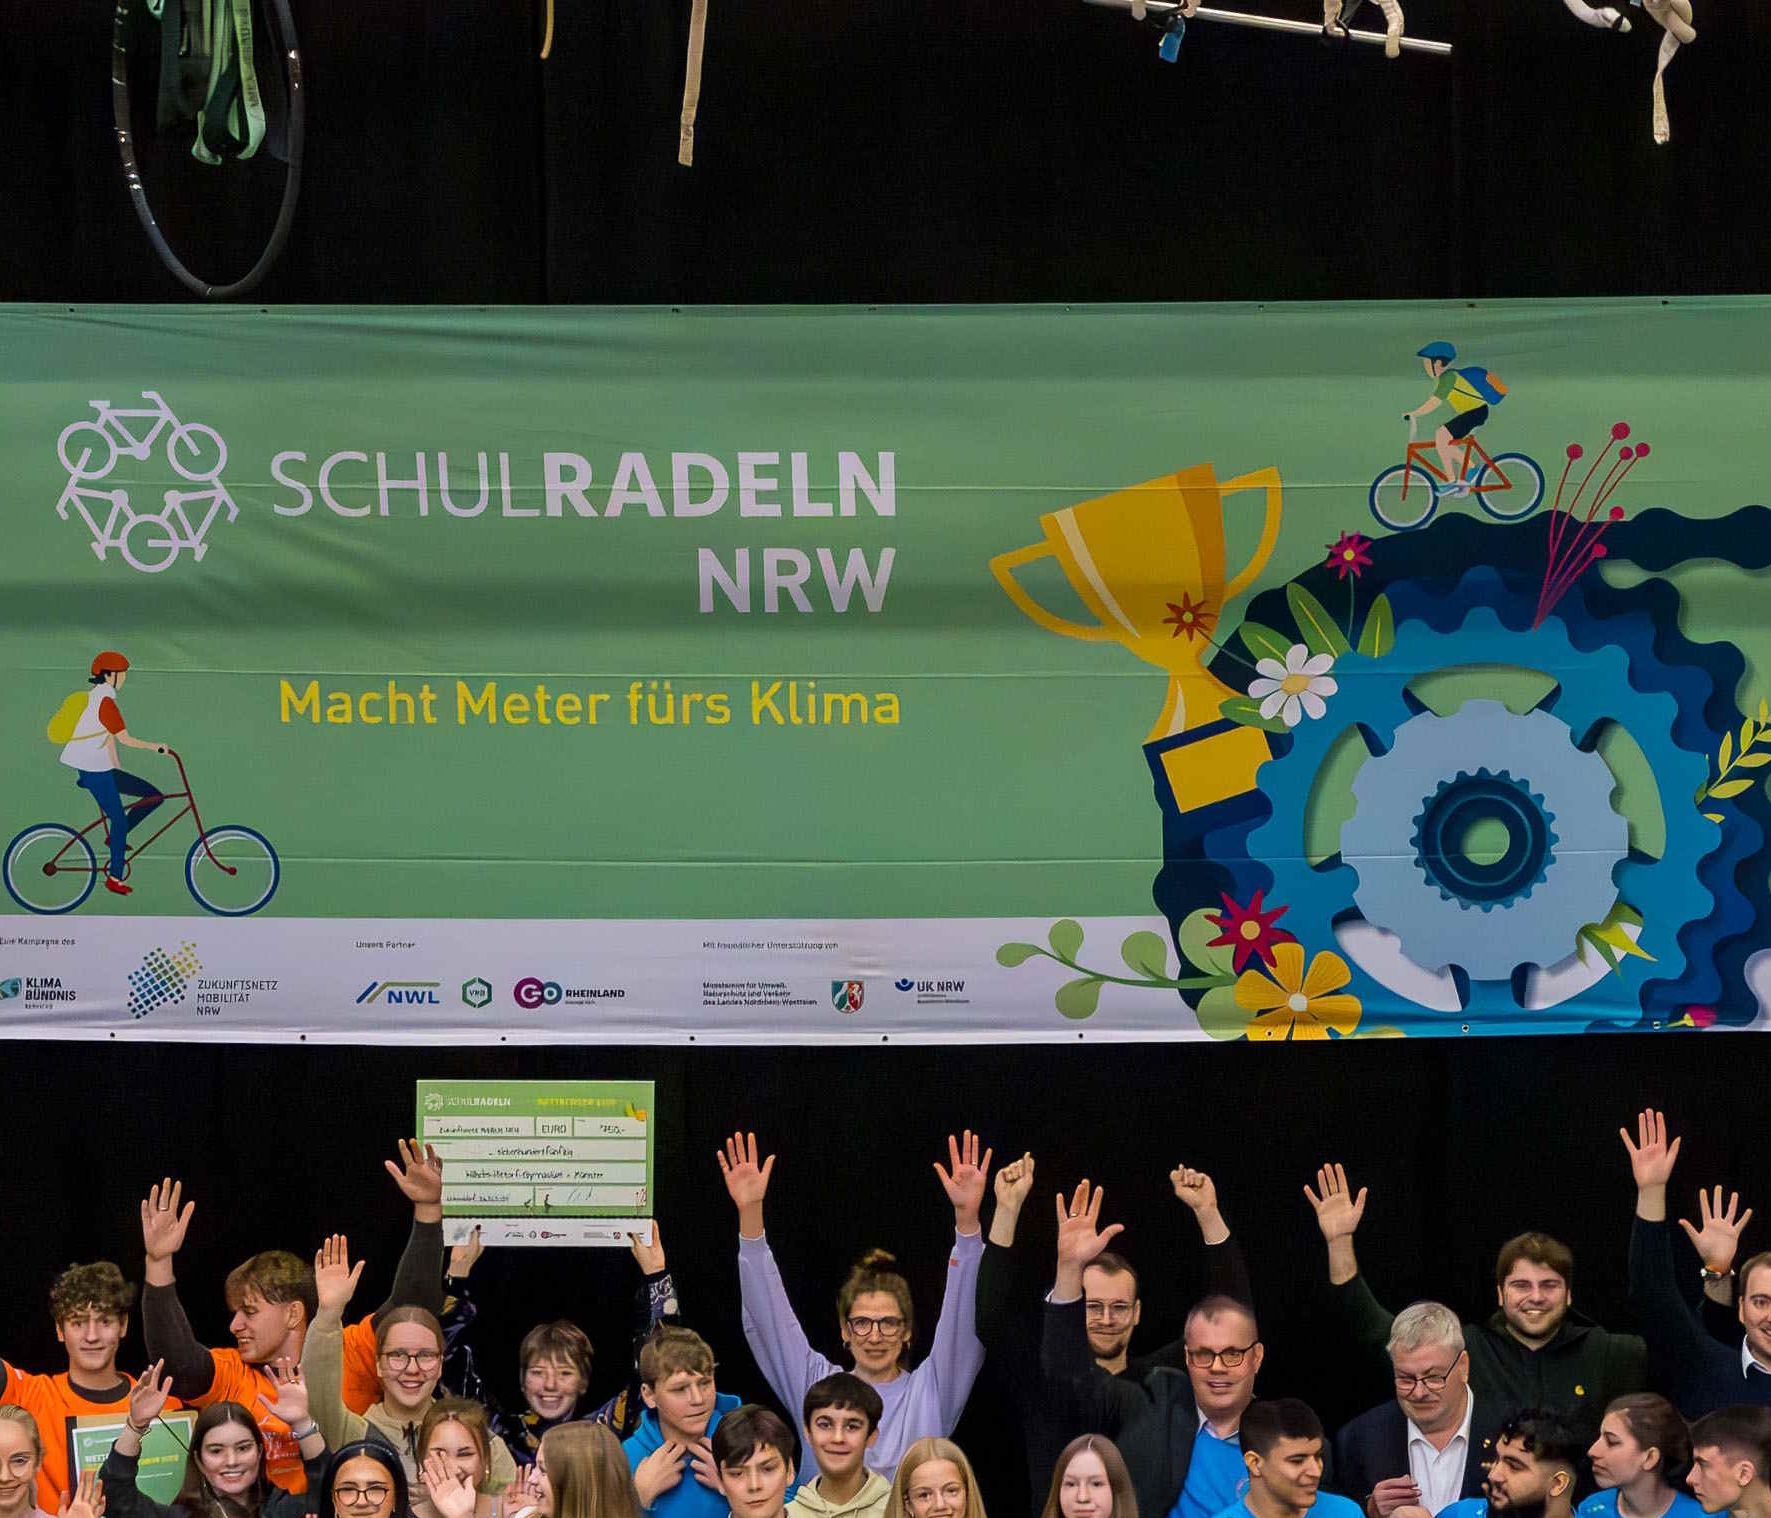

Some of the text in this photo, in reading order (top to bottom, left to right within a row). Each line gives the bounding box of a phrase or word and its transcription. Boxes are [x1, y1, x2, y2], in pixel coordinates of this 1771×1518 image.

[271, 450, 898, 519] SCHULRADELN
[697, 546, 897, 614] NRW
[280, 680, 901, 726] Macht Meter fürs Klima
[26, 978, 62, 988] KLIMA
[197, 980, 278, 990] ZUKUNFTSNETZ
[917, 981, 965, 992] UK NRW
[25, 988, 76, 1000] BÜNDNIS
[197, 992, 251, 1003] MOBILITÄT
[387, 990, 440, 1004] NWL
[565, 989, 625, 998] RHEINLAND
[196, 1006, 221, 1016] NRW
[541, 1125, 567, 1134] EURO
